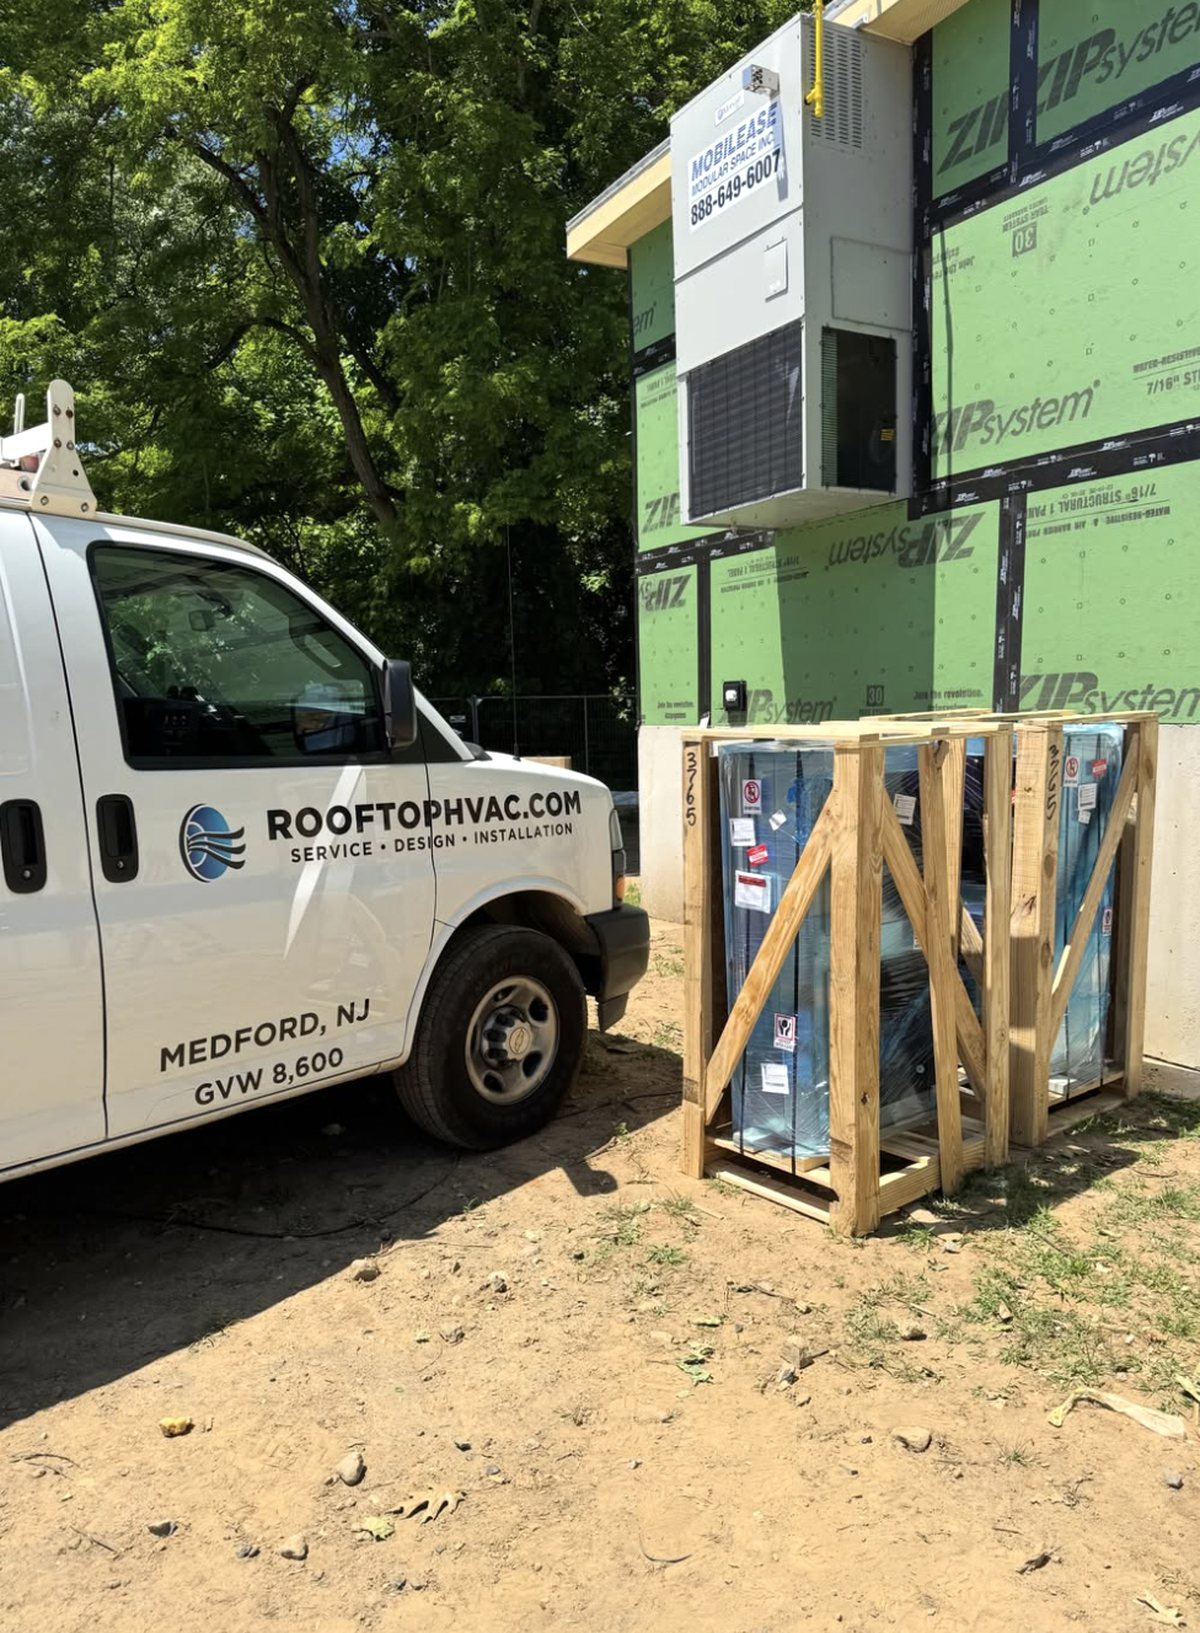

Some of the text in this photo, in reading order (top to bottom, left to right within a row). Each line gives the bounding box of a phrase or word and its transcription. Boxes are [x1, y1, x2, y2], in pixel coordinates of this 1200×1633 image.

[692, 101, 778, 181] MOBILEASE
[691, 162, 729, 197] MODULAR
[730, 142, 757, 170] SPACE
[691, 147, 781, 225] 888-649-6007
[1013, 225, 1036, 252] 30
[1058, 490, 1122, 513] STRUCTURAL
[867, 686, 884, 705] 30
[266, 790, 582, 841] ROOFTOPHVAC.COM
[685, 751, 698, 827] 3765
[291, 822, 574, 863] SERVICE DESIGN INSTALLATION
[160, 998, 370, 1073] MEDFORD, NJ
[195, 1047, 344, 1105] GVW 8,600
